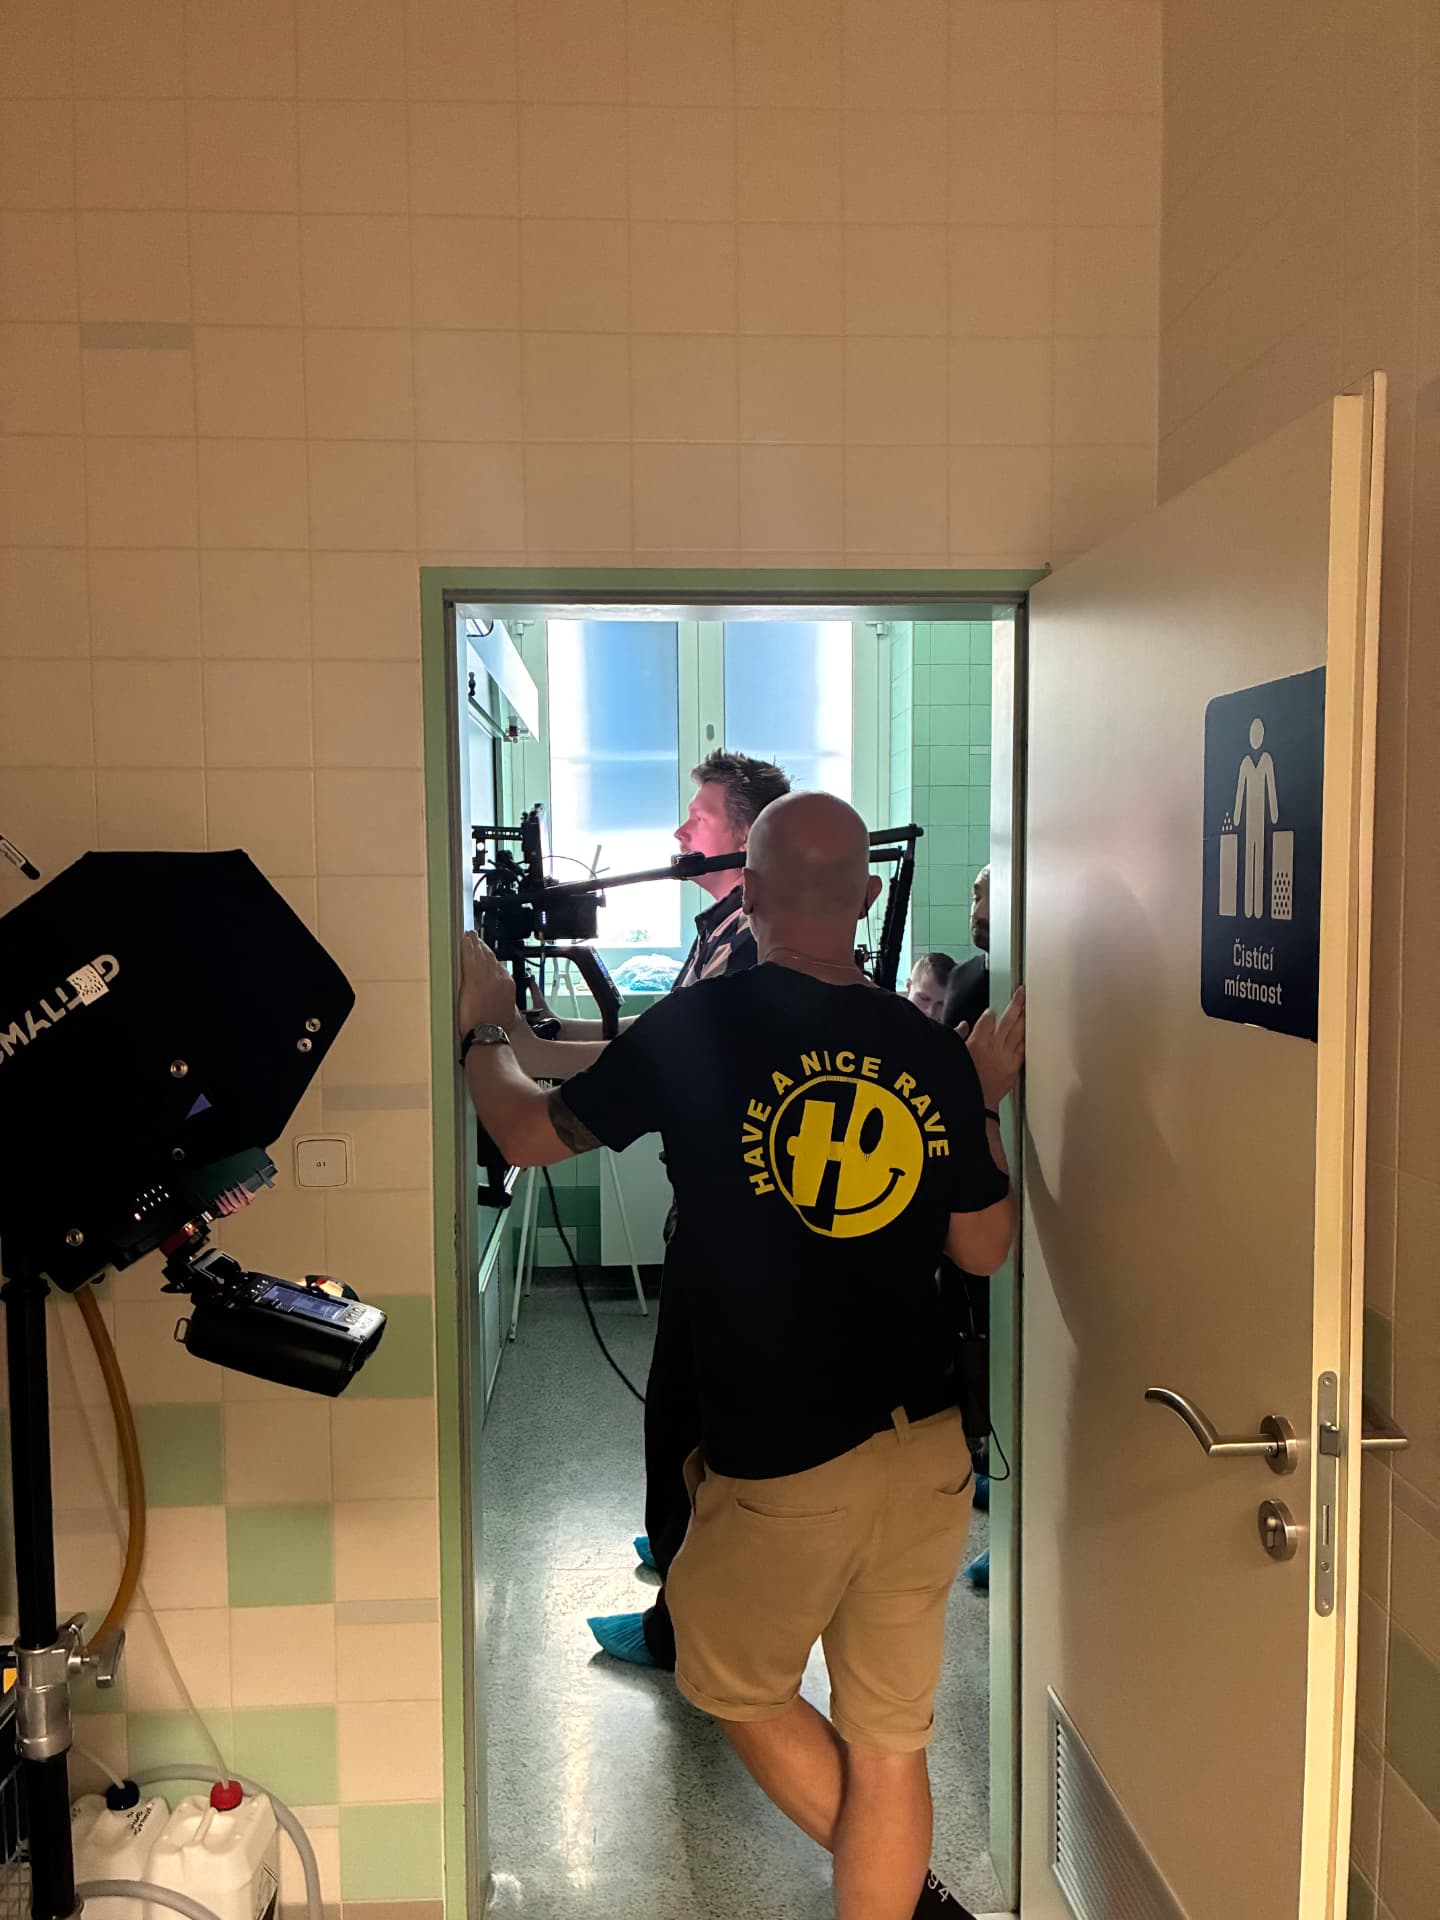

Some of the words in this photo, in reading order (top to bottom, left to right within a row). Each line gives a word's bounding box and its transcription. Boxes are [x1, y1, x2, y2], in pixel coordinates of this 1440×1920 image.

[1233, 938, 1274, 971] Čistící
[1225, 974, 1282, 1006] místnost
[741, 1098, 776, 1196] HAVE
[771, 1071, 795, 1096] A
[800, 1050, 882, 1079] NICE
[894, 1071, 951, 1158] RAVE
